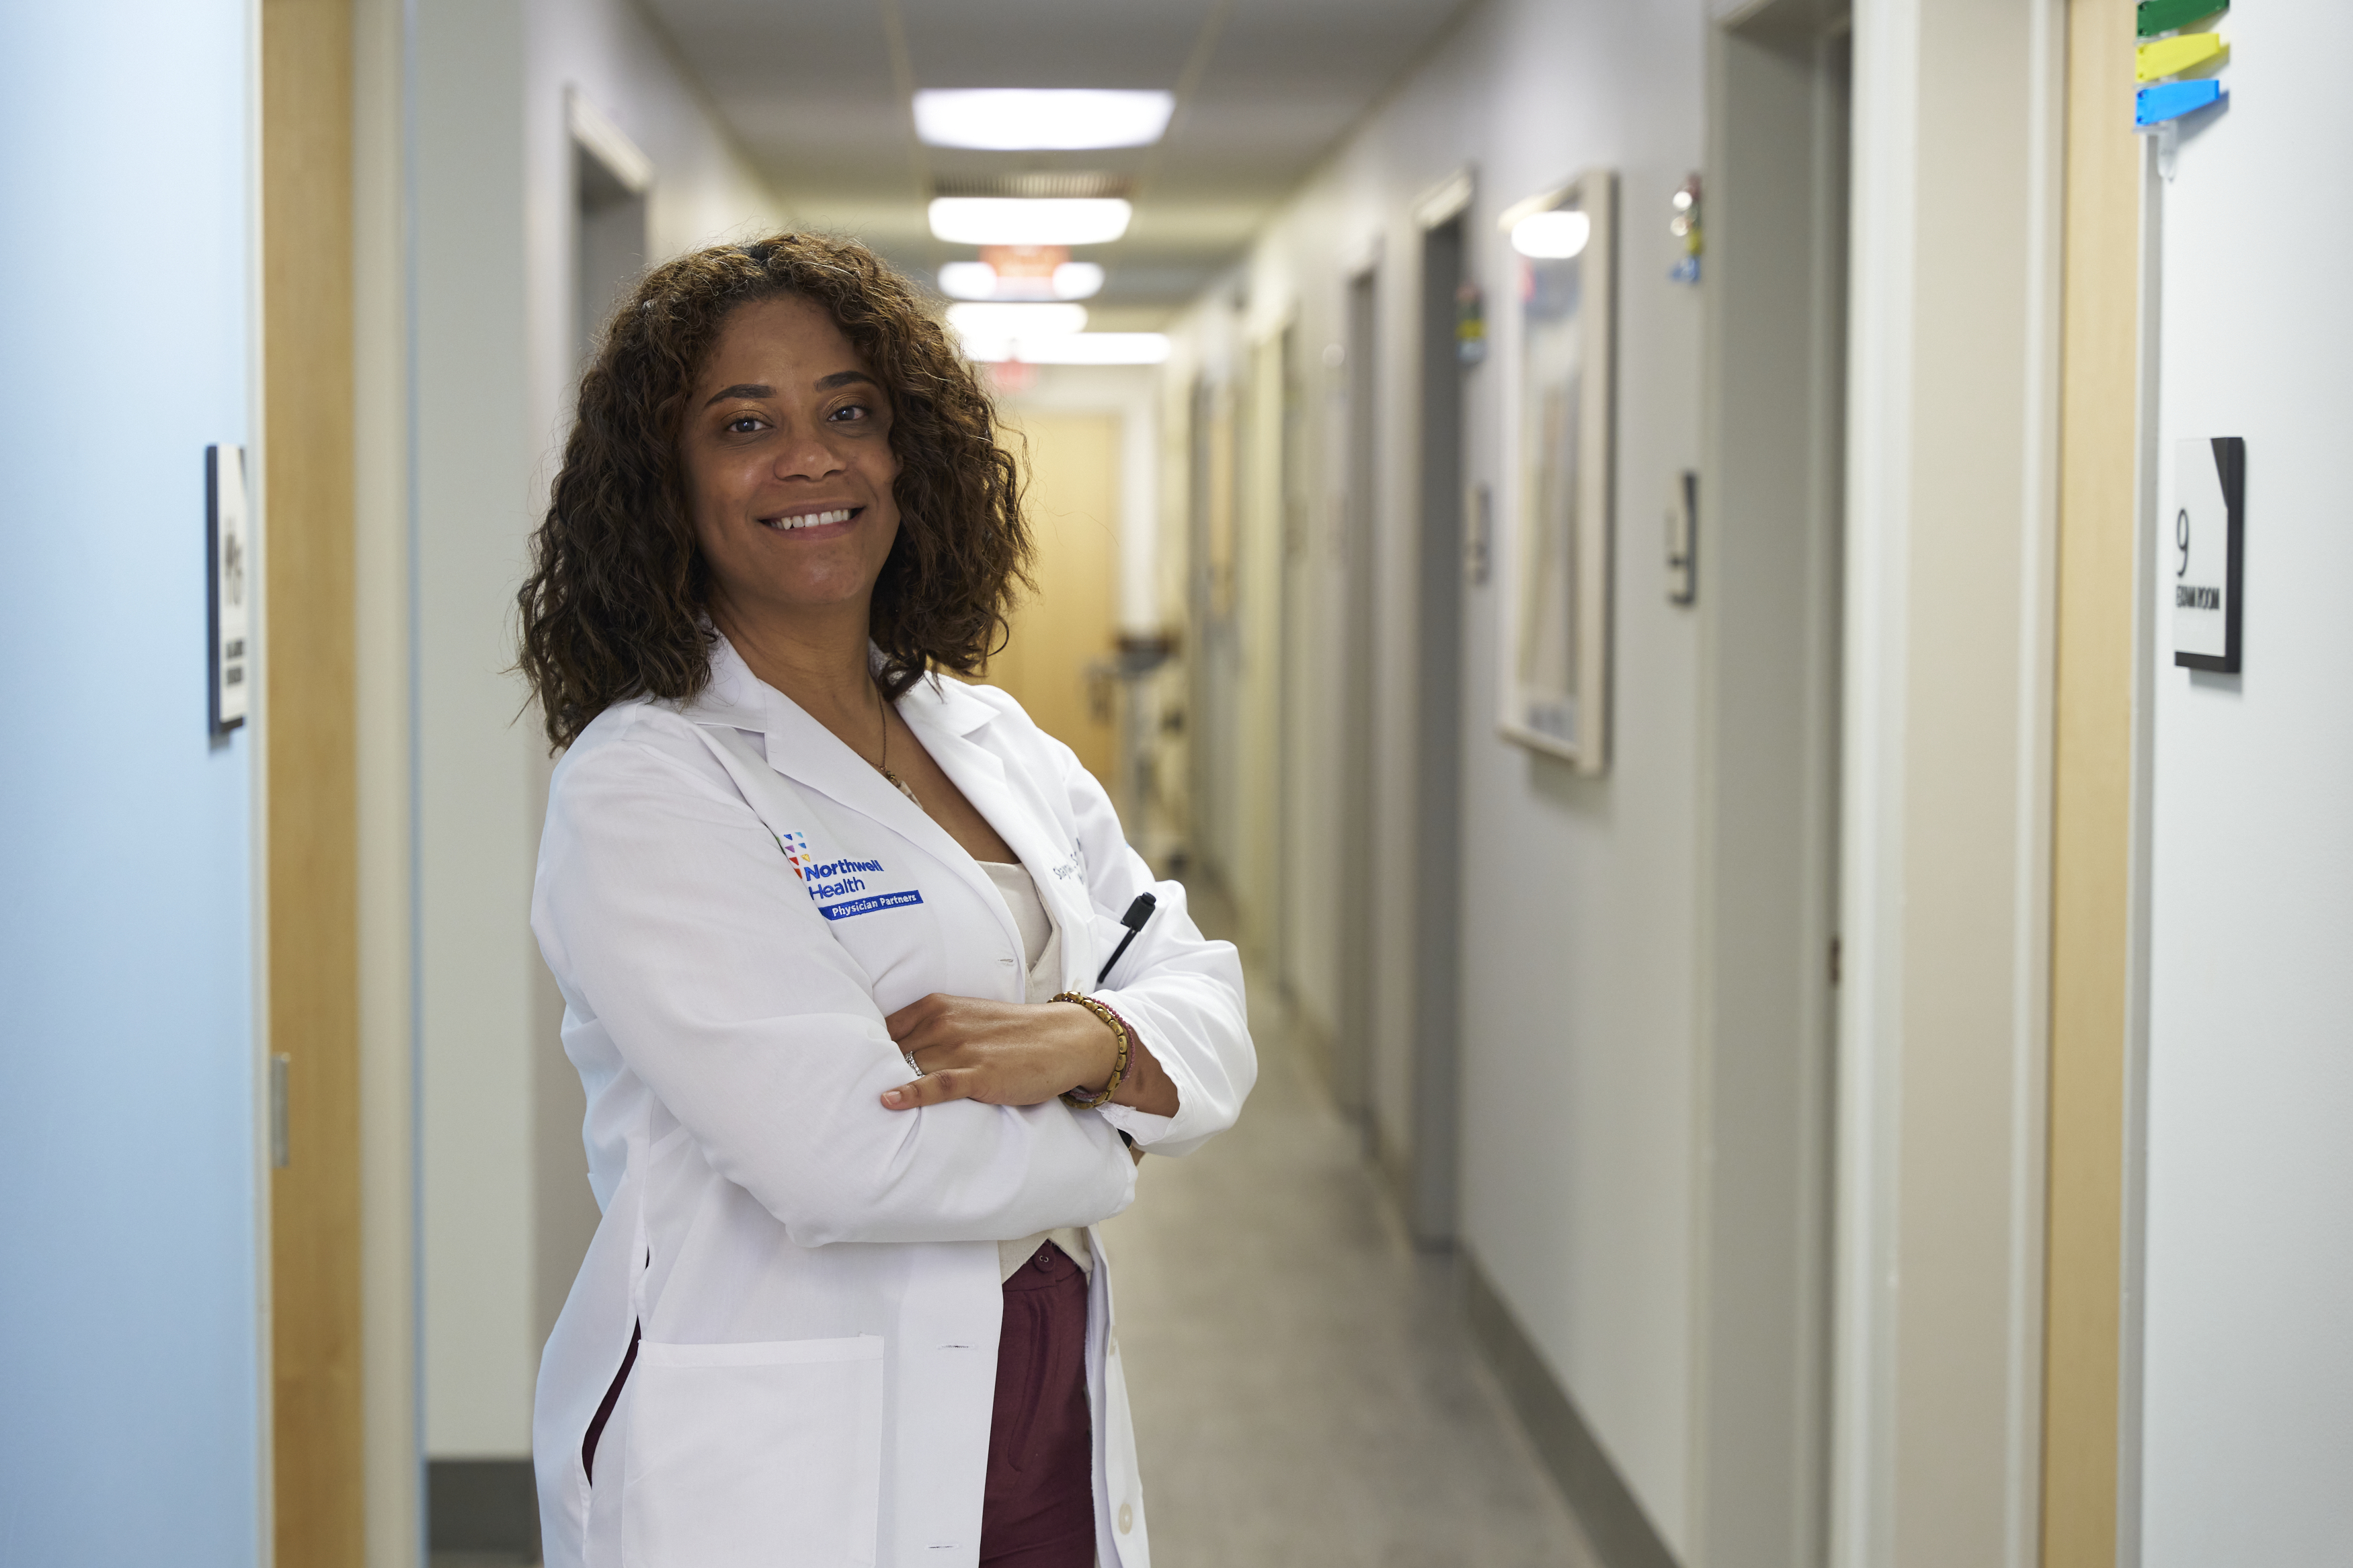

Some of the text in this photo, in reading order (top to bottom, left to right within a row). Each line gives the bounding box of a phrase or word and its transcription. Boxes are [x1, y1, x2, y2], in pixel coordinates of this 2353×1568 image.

[2178, 508, 2189, 577] 9
[804, 859, 884, 881] Northwell
[809, 876, 865, 900] Health
[832, 894, 917, 917] Physician Partners
